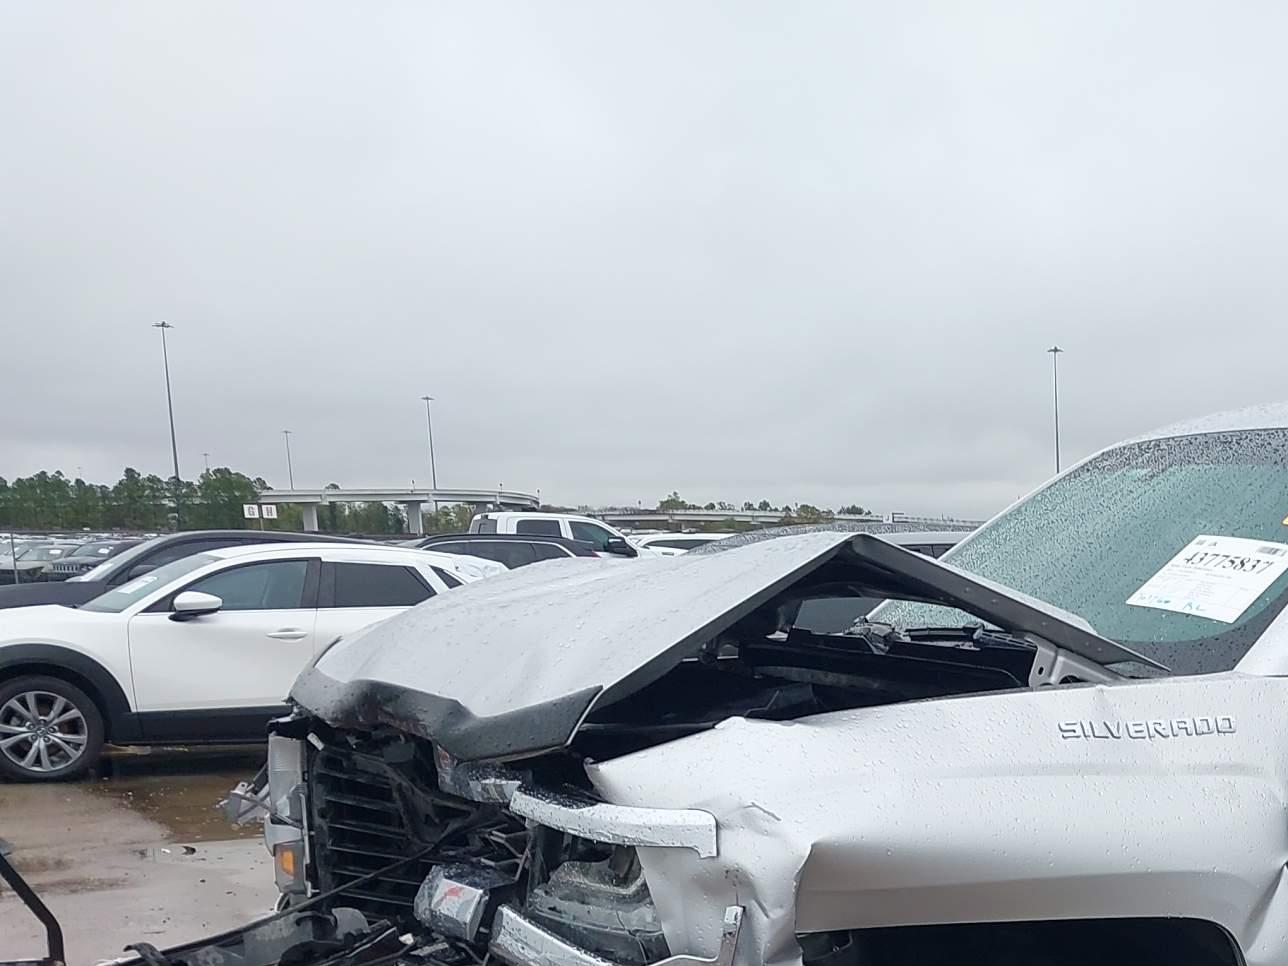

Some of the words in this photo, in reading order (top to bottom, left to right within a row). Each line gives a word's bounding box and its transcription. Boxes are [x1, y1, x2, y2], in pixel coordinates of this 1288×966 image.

[247, 506, 255, 517] G
[265, 506, 273, 517] H
[1184, 551, 1274, 574] 43775837
[1057, 715, 1237, 740] SILVERADO
